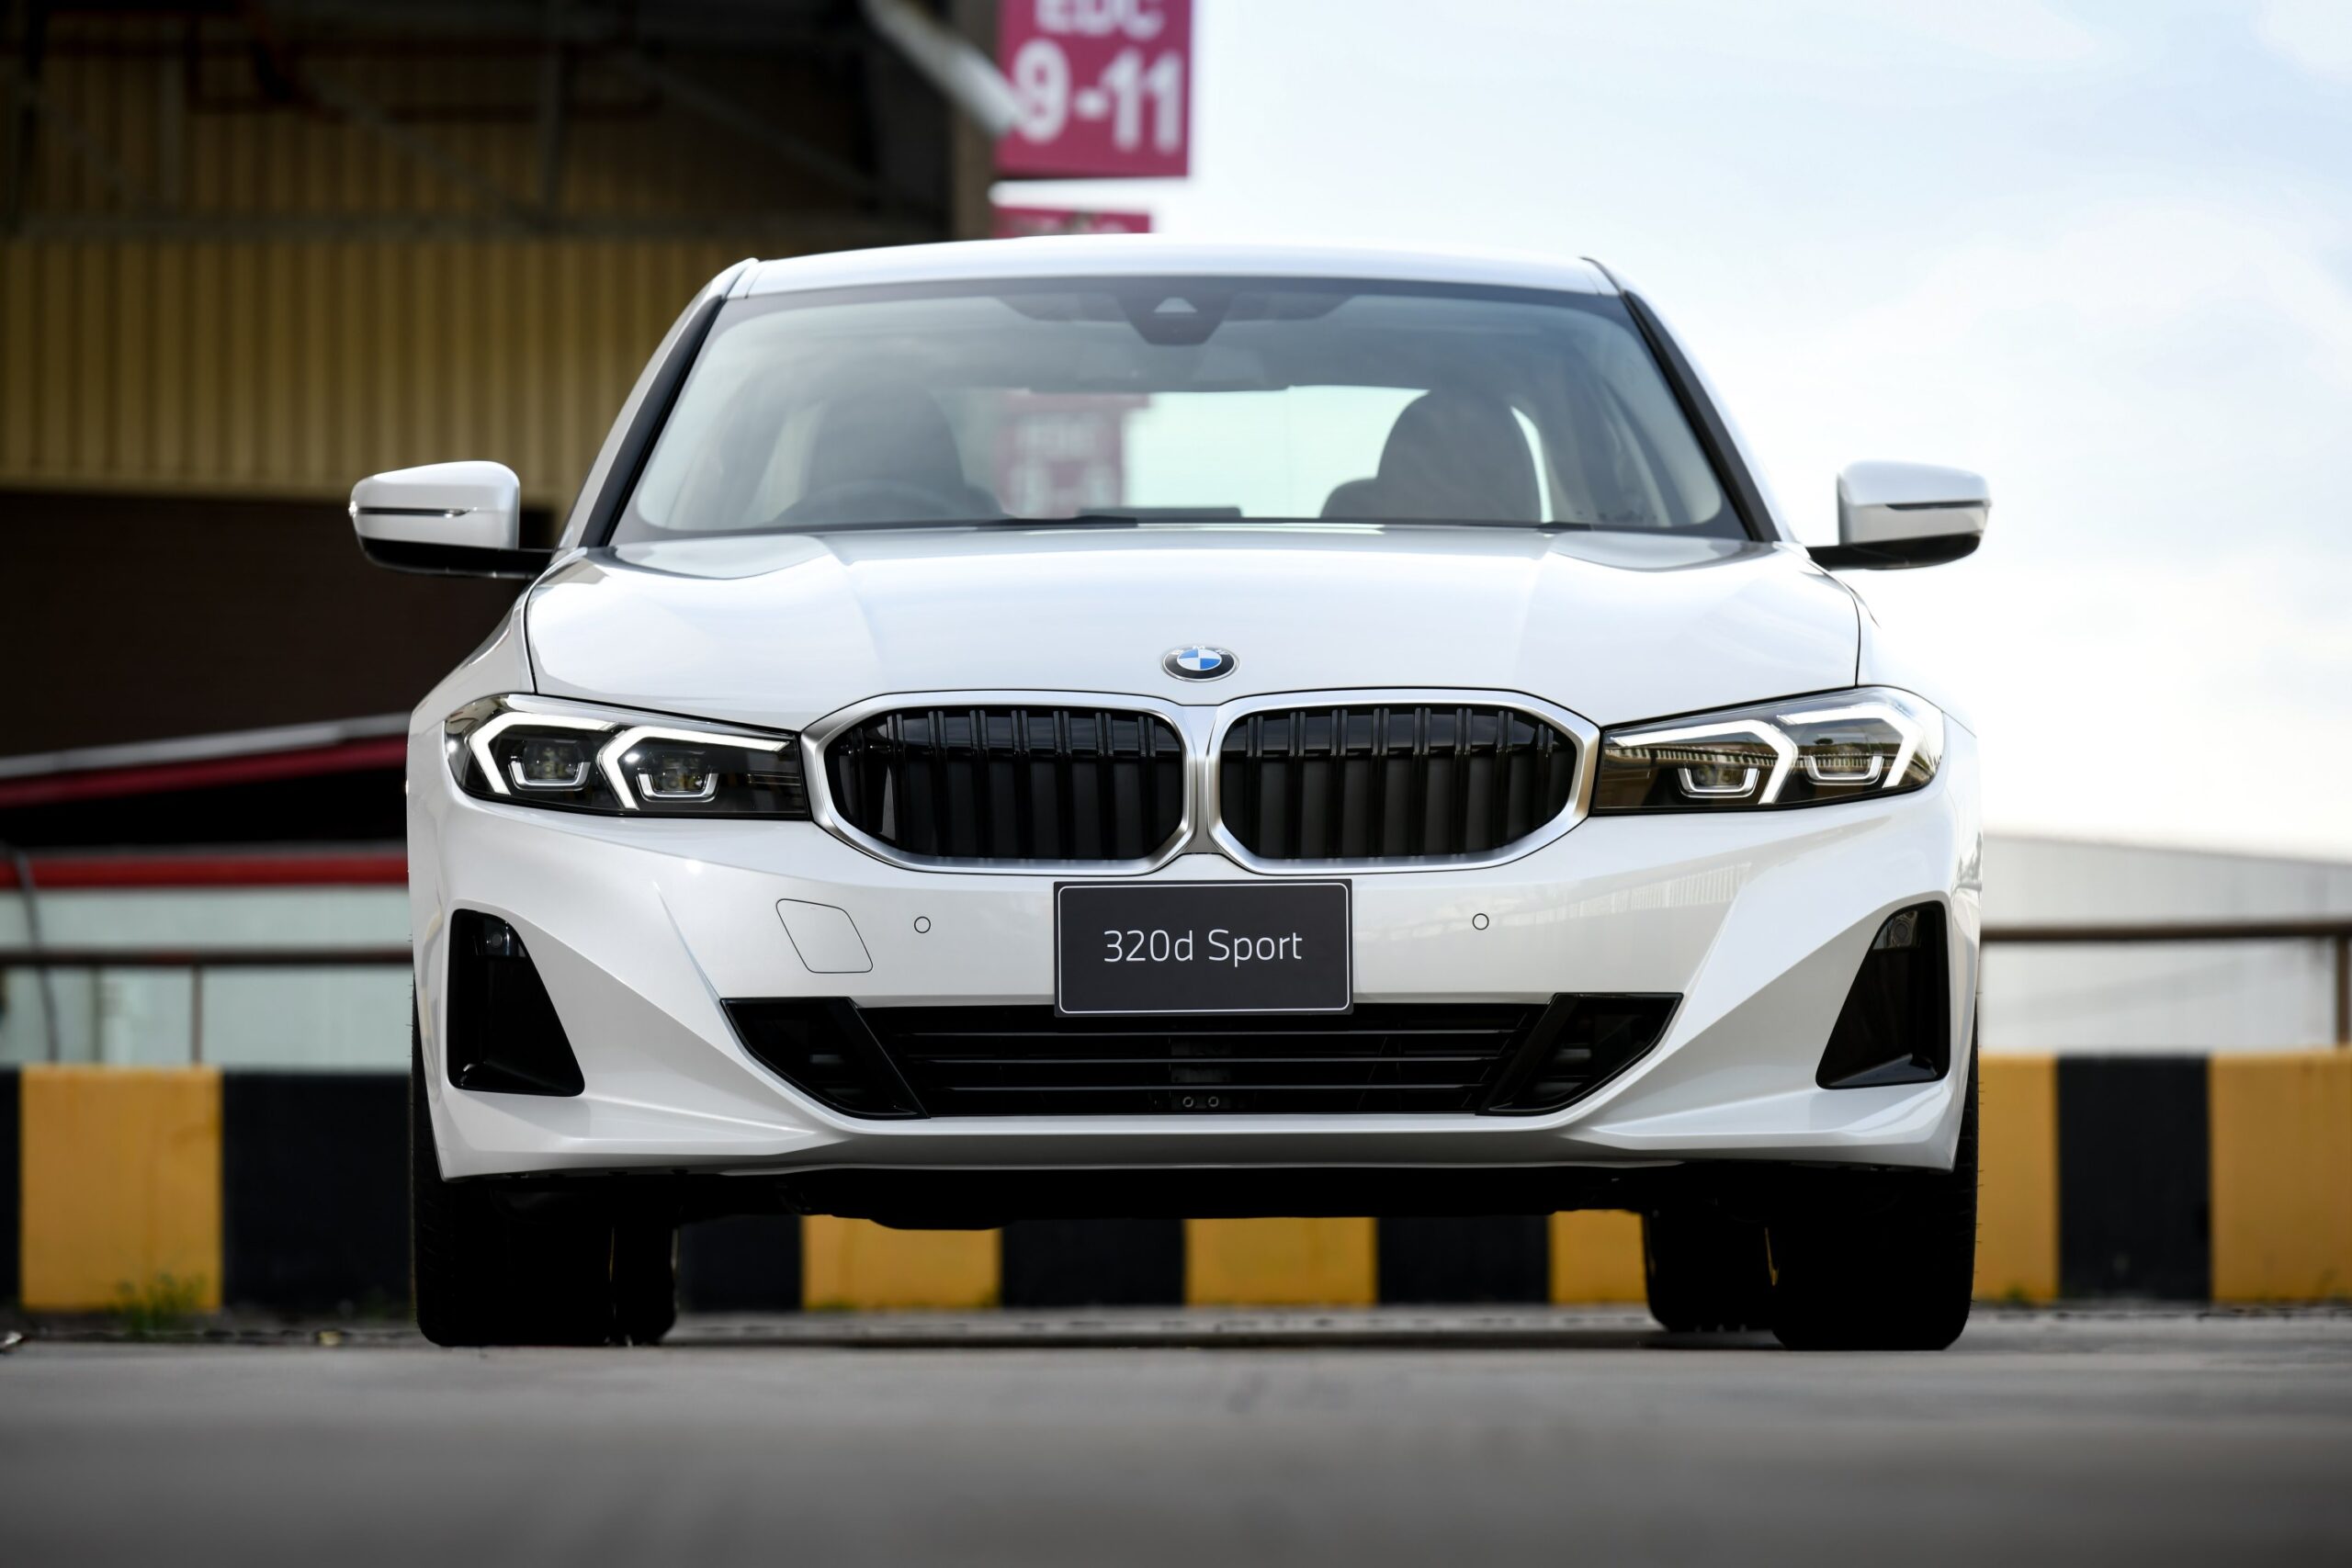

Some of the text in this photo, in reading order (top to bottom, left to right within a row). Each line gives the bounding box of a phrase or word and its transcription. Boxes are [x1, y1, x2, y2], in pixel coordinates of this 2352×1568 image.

[1012, 39, 1182, 152] 9-11
[1103, 929, 1303, 968] 320d Sport
